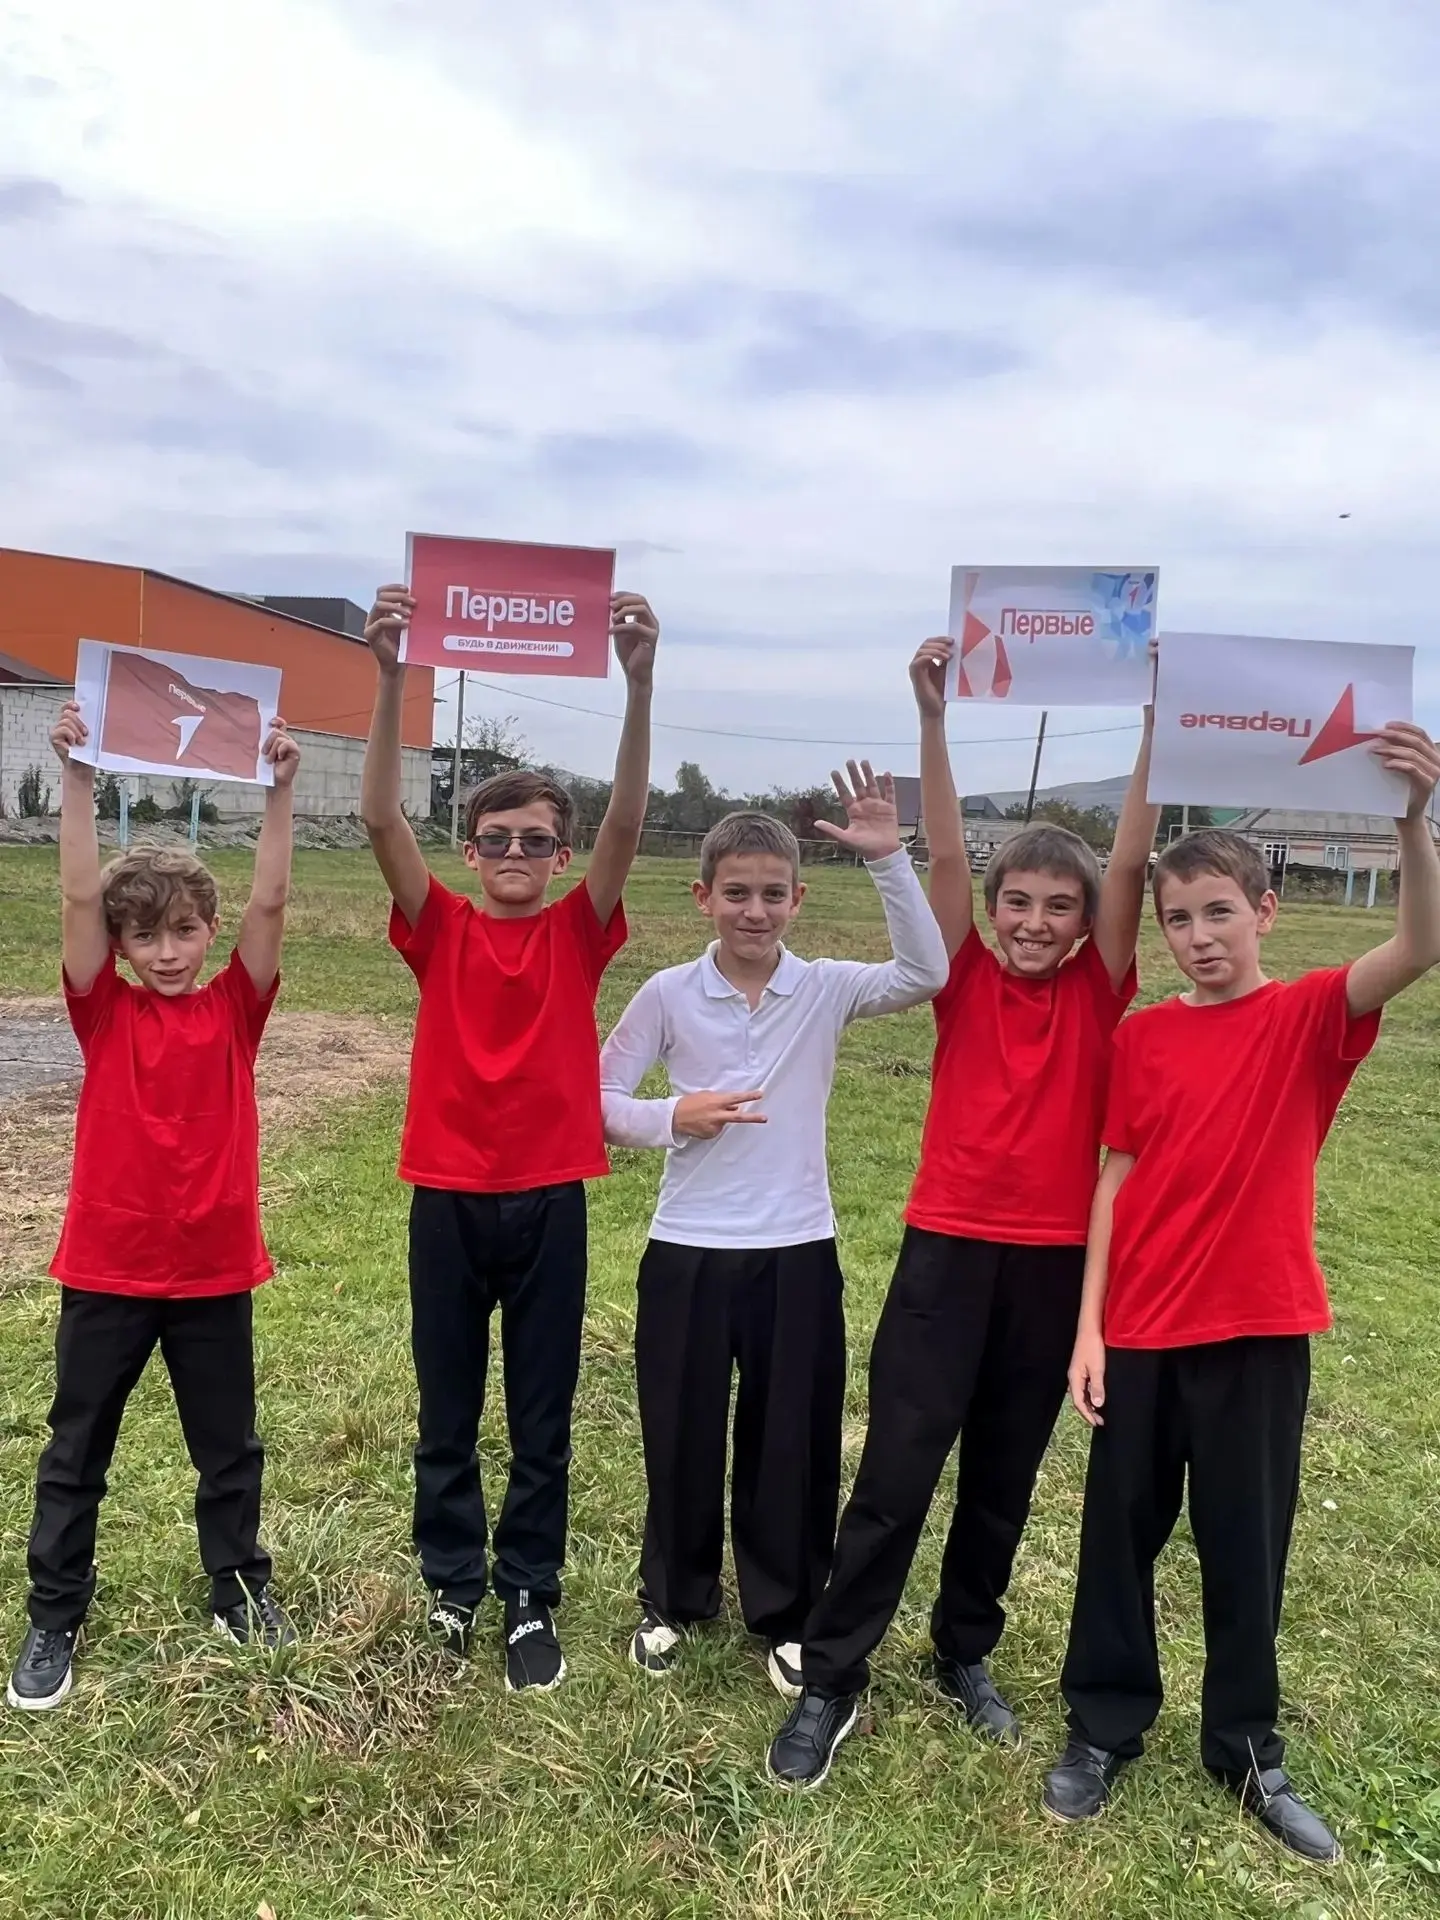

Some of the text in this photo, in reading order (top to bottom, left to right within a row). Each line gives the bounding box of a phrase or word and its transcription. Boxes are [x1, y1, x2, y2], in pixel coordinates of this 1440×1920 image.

[446, 585, 575, 632] Первые
[1000, 608, 1094, 644] Первые
[457, 638, 559, 653] БУДЬ В ДВИЖЕНИИ!
[168, 683, 206, 713] Первые
[1180, 710, 1312, 738] Первые
[508, 1620, 544, 1645] adidas
